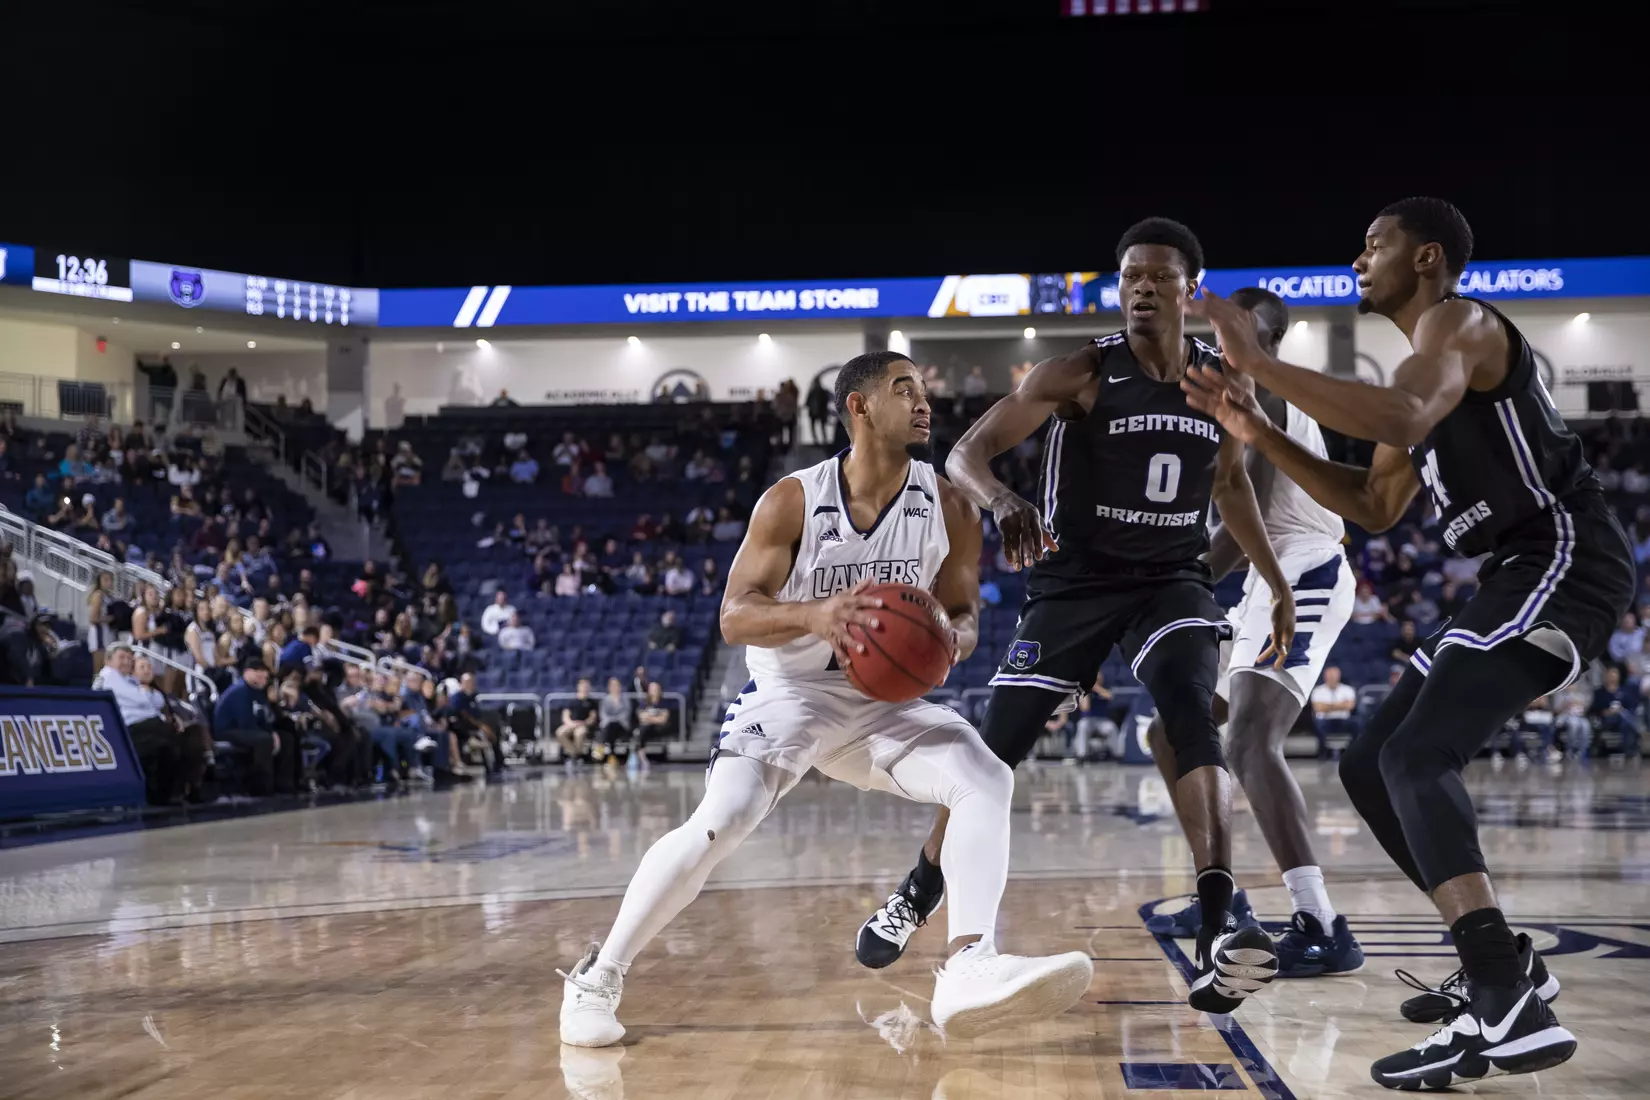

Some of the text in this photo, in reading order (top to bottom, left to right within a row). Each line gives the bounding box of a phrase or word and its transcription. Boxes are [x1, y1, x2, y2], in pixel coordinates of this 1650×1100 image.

[56, 254, 108, 285] 12:36
[624, 288, 880, 313] VISIT THE TEAM STORE!
[1108, 414, 1220, 443] CENTRAL
[1145, 452, 1182, 502] 0
[903, 507, 929, 519] WAC
[1096, 504, 1200, 527] ARKANSAS
[819, 534, 844, 543] adidas
